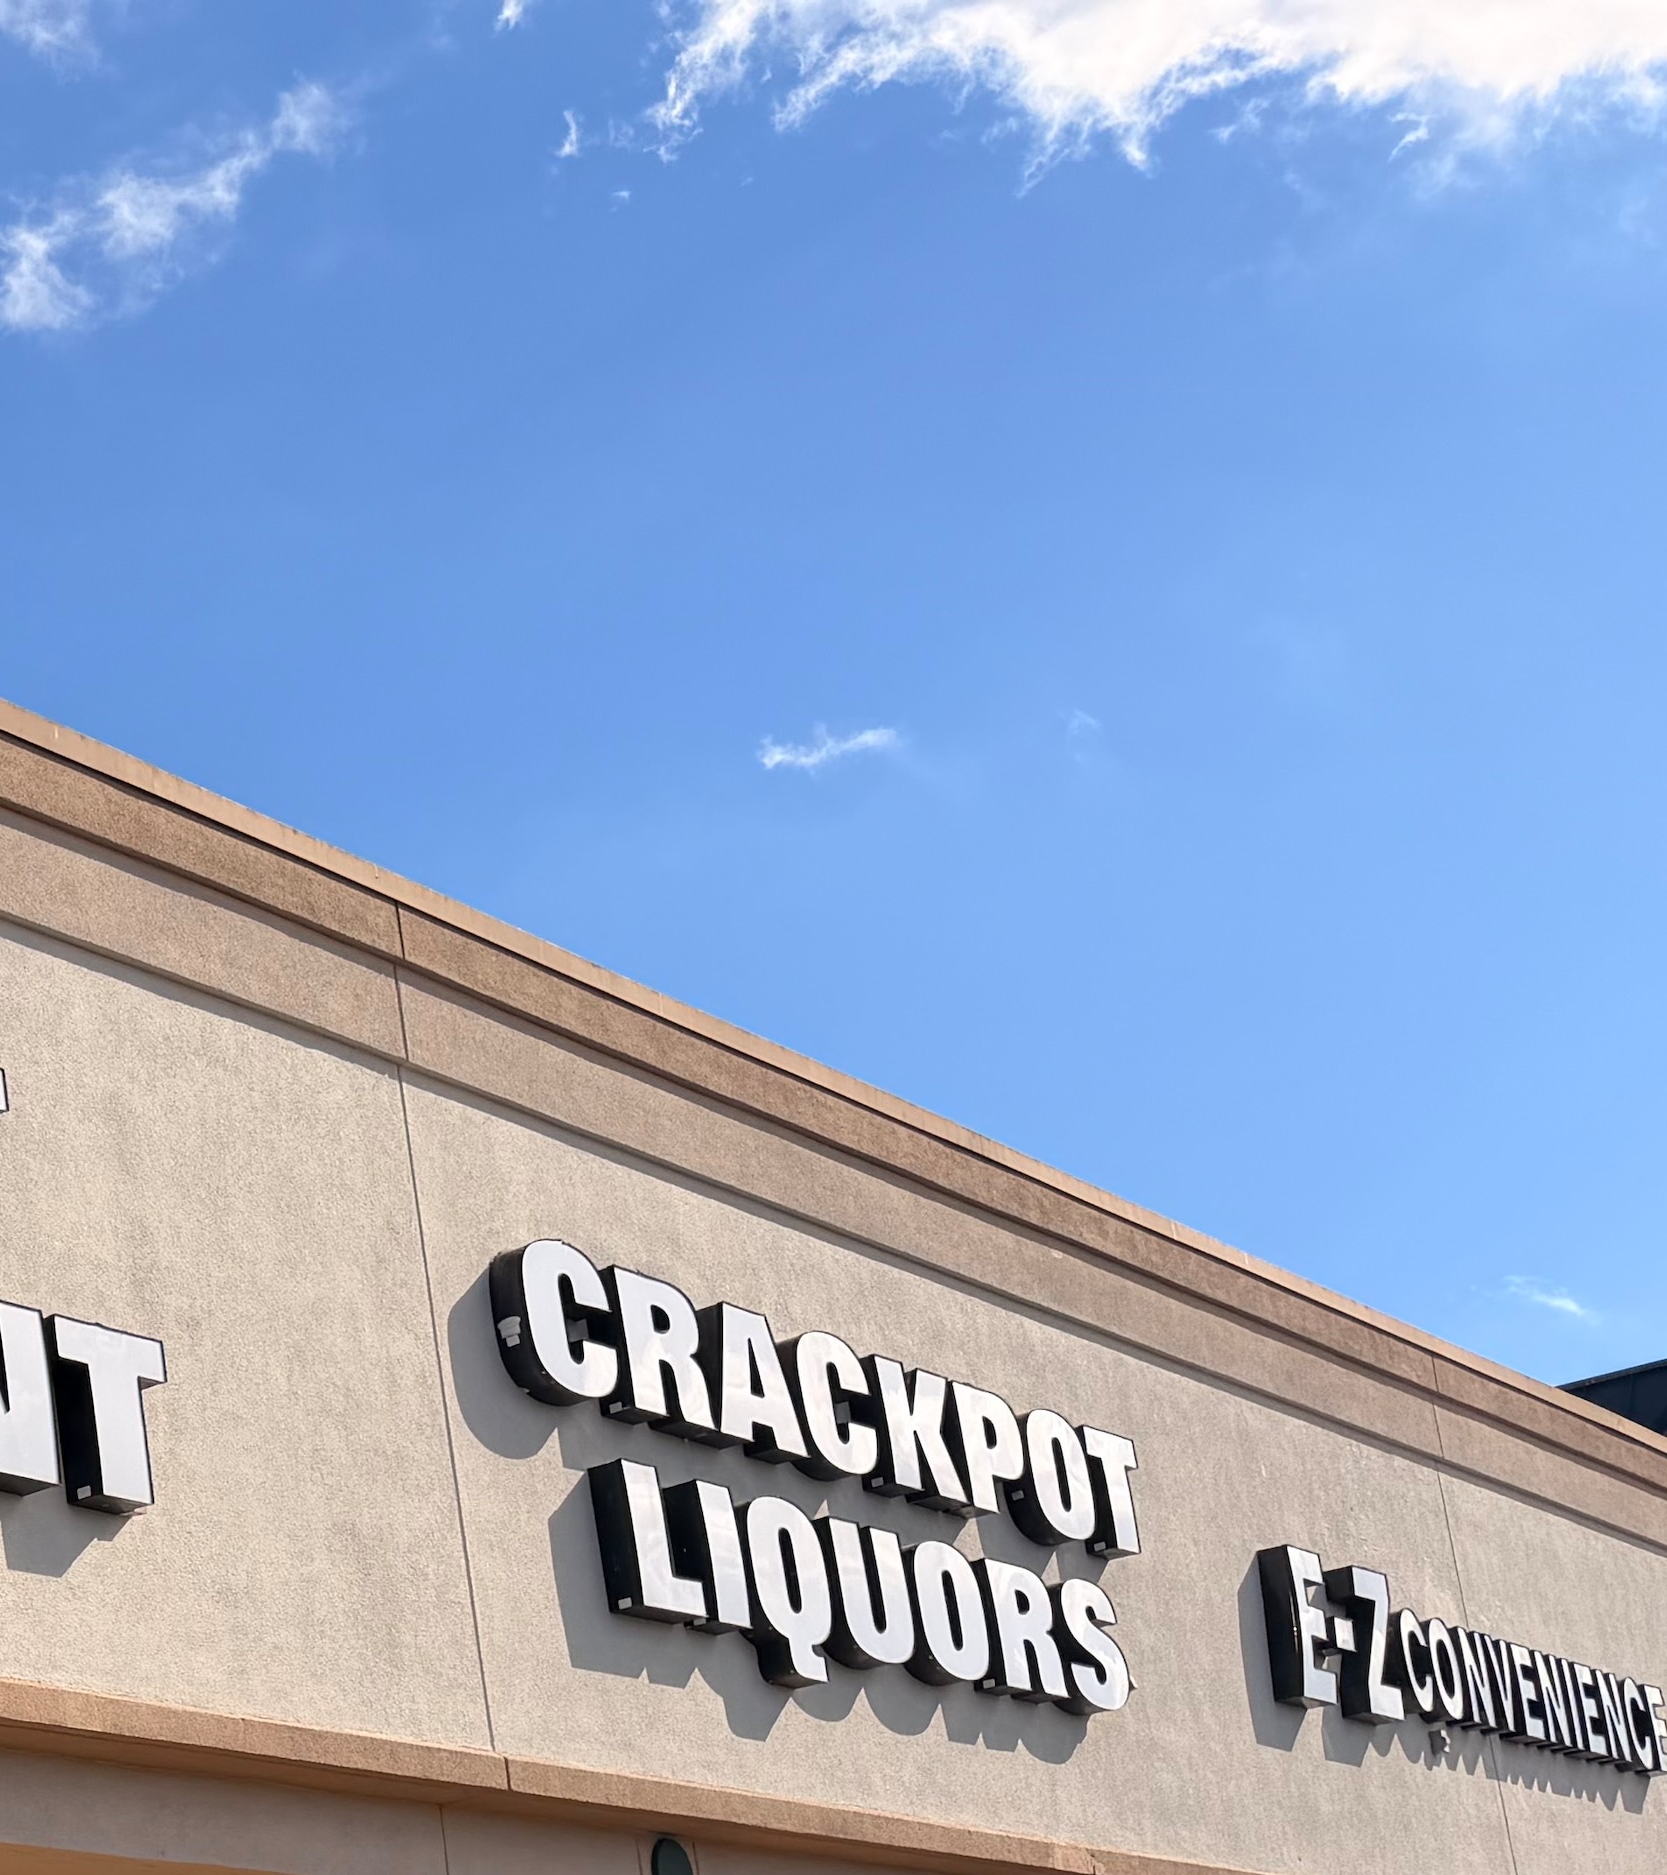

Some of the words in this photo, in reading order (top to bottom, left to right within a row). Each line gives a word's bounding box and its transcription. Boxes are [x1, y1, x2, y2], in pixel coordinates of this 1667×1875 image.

[489, 1238, 1142, 1560] CRACKPOT
[587, 1457, 1135, 1716] LIQUORS
[1257, 1544, 1405, 1725] E-Z
[1395, 1607, 1667, 1778] CONVENIENCE
